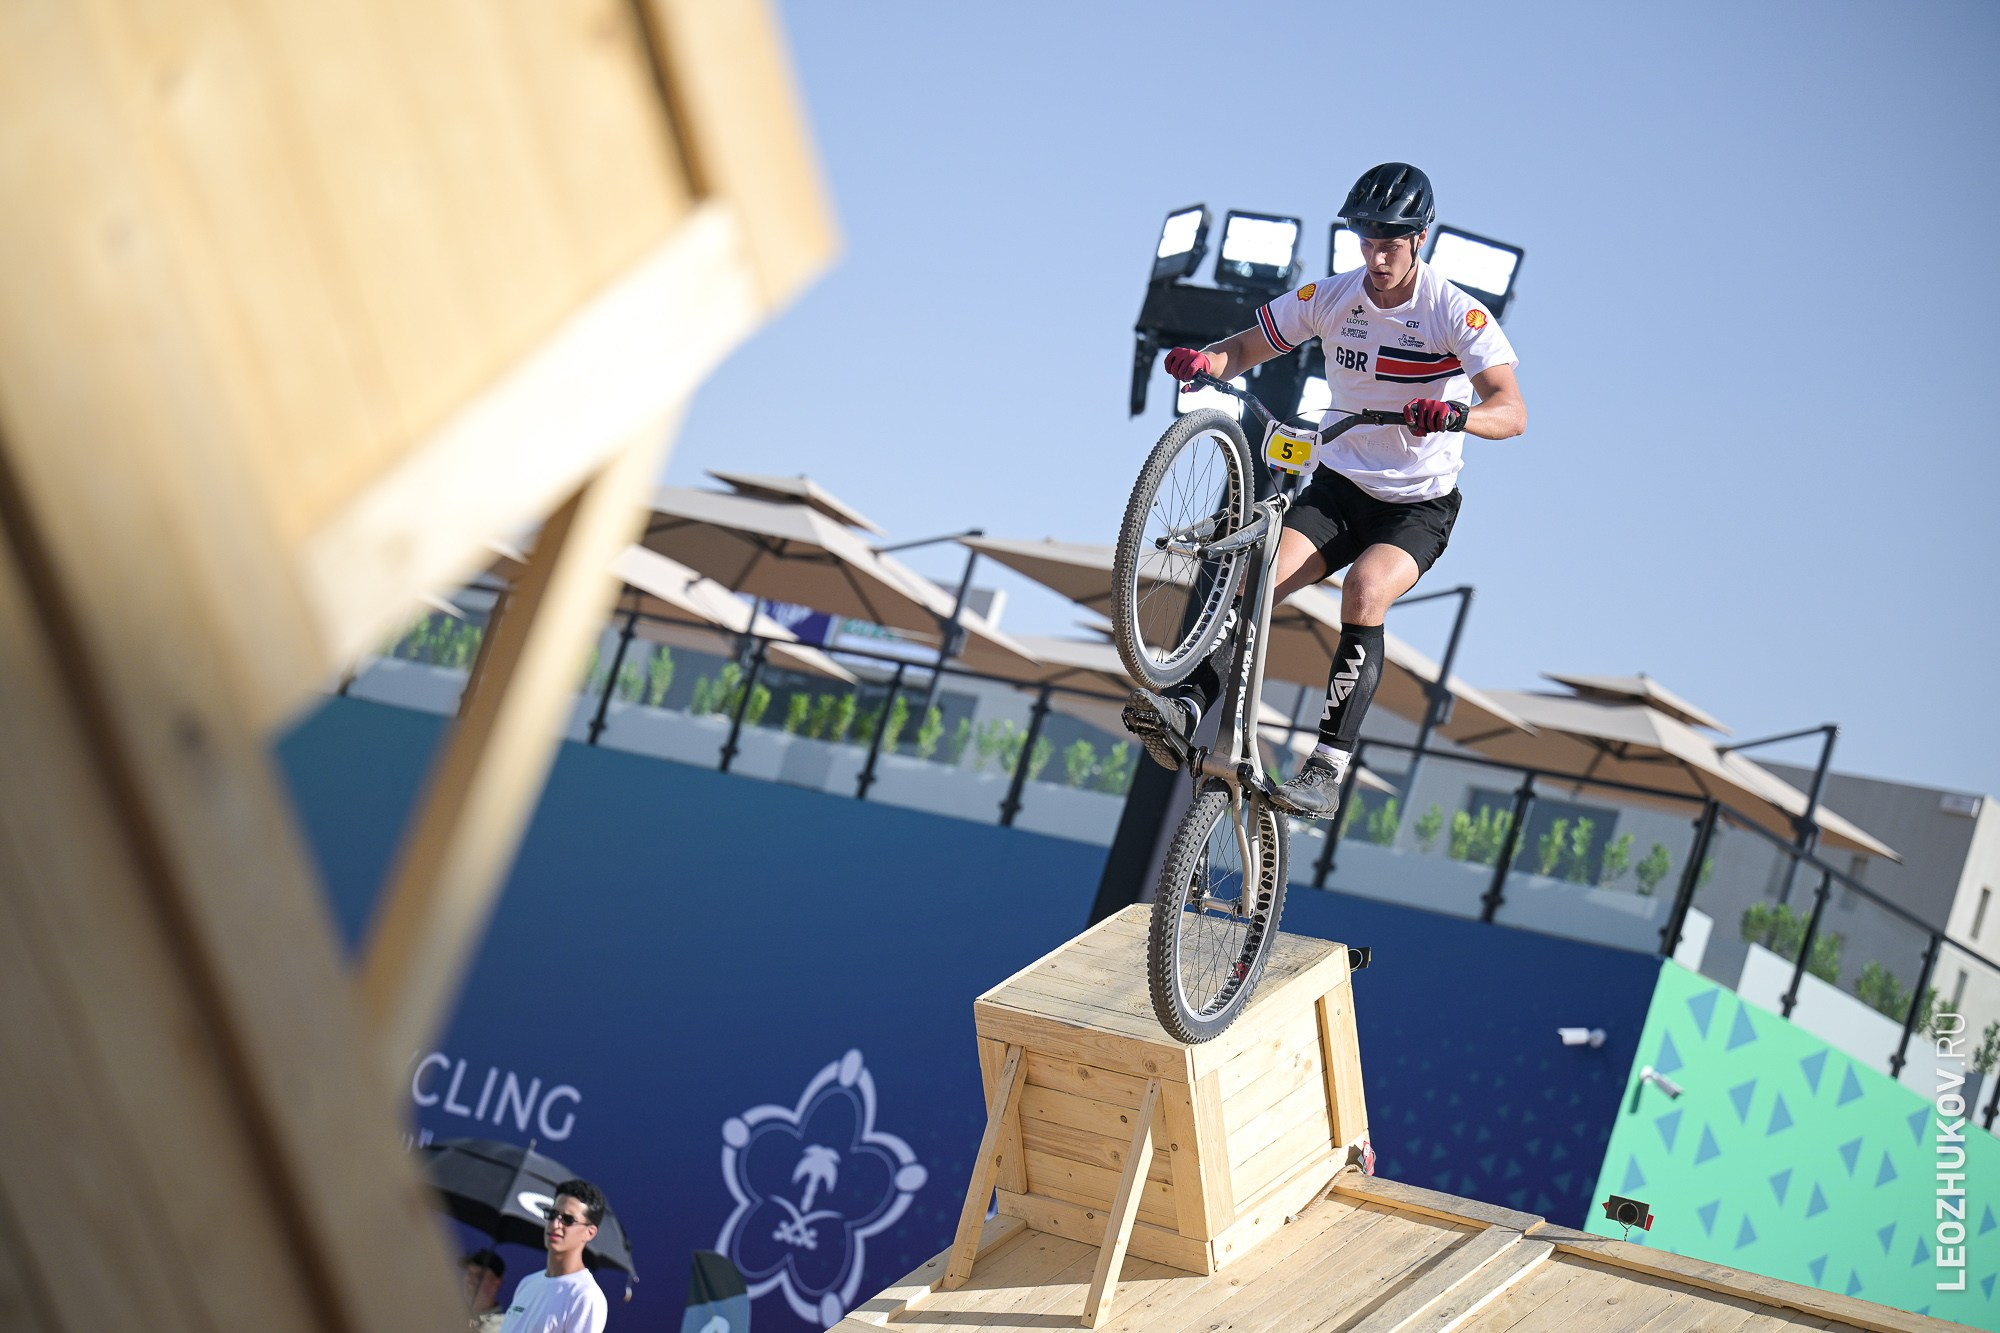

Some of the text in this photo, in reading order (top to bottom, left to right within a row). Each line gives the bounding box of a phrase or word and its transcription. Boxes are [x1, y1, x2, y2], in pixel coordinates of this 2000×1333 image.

[1346, 317, 1369, 327] LLOYDS
[1347, 327, 1368, 335] BRITISH
[1346, 332, 1367, 340] CYCLING
[1335, 346, 1369, 373] GBR
[1280, 441, 1294, 460] 5
[1320, 644, 1367, 721] WAW
[409, 1049, 582, 1142] CLING
